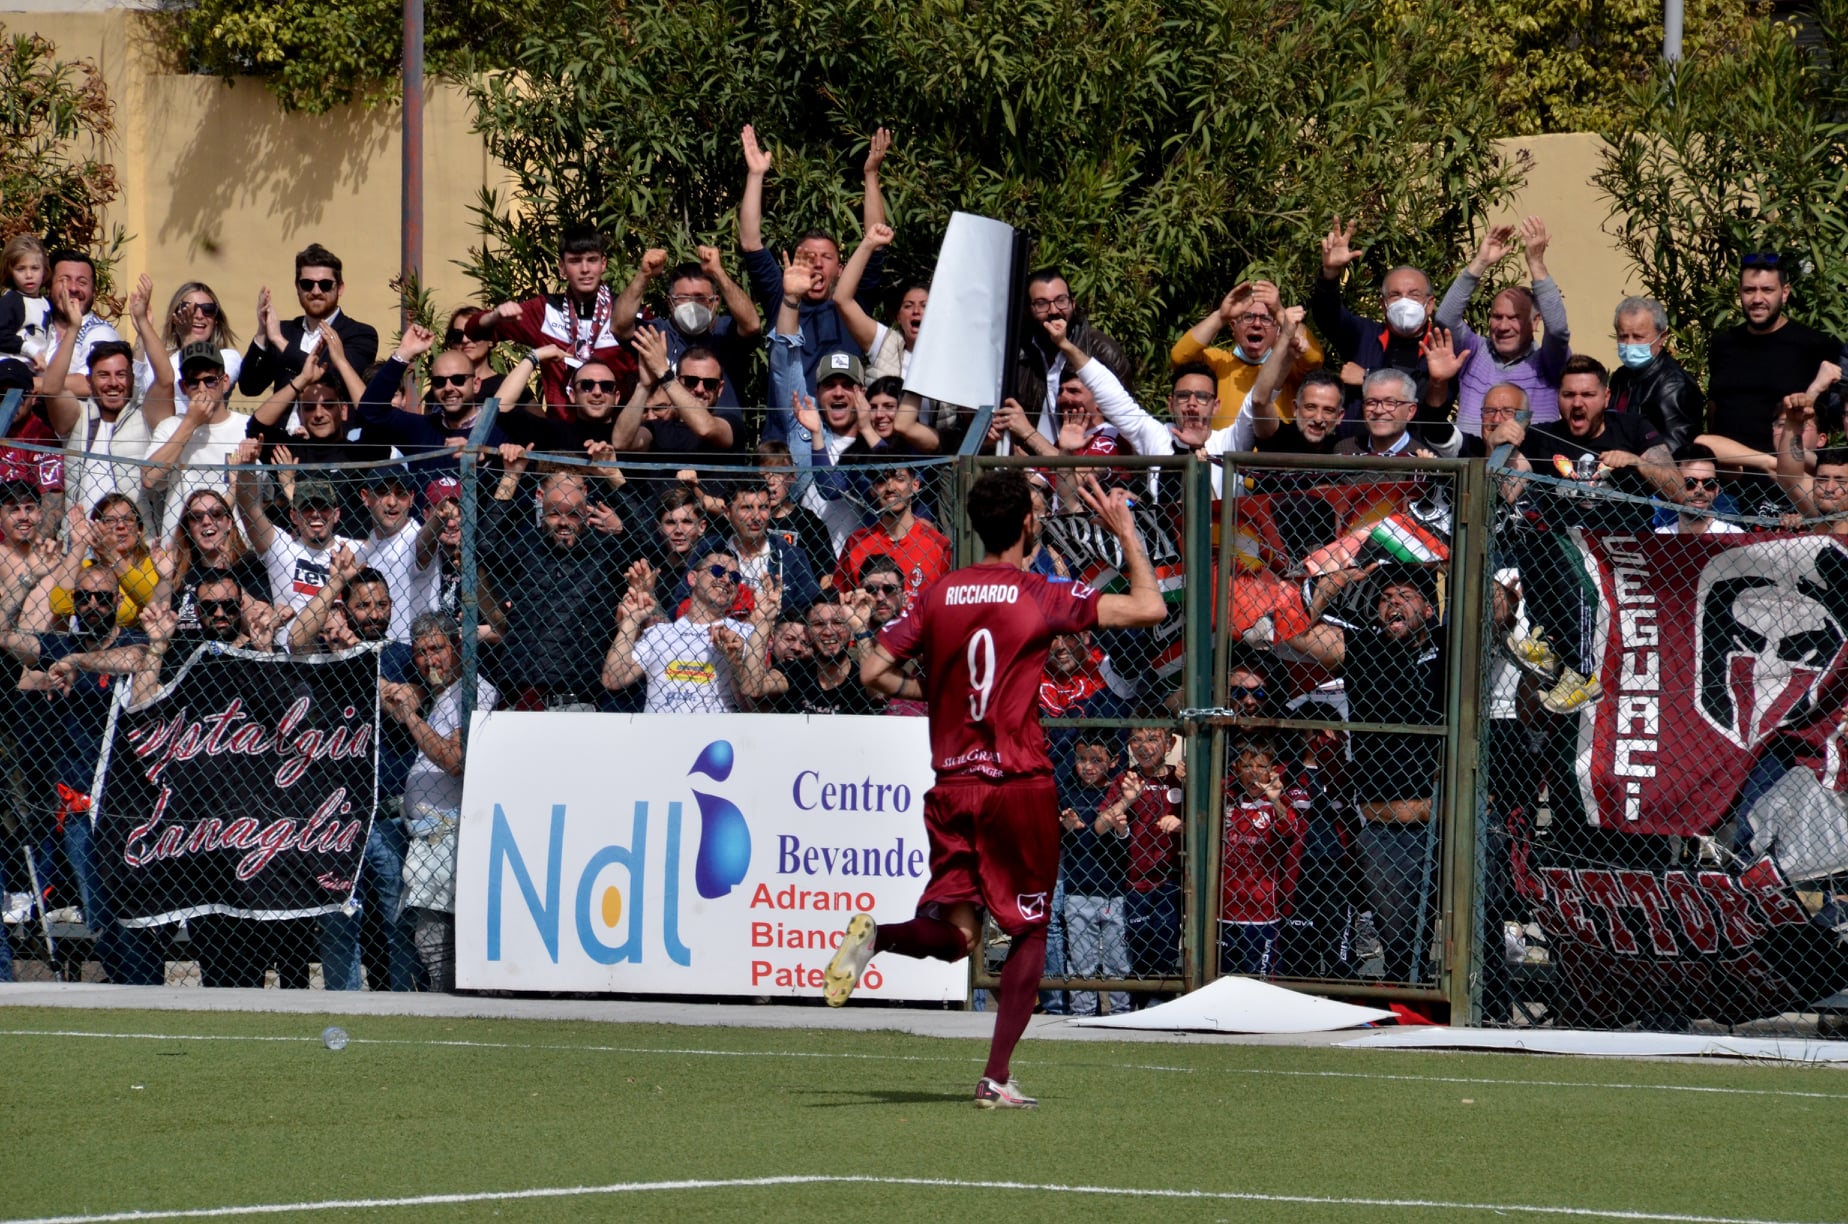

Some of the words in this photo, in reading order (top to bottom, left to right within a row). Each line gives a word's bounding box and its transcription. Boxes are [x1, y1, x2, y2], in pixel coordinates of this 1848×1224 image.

[1039, 509, 1180, 568] BROX
[945, 585, 1018, 605] RICCIARDO
[967, 628, 996, 721] 9
[793, 770, 911, 813] Centro
[776, 835, 924, 877] Bevande
[750, 883, 875, 911] Adrano
[751, 922, 846, 950] Bianc
[751, 960, 884, 990] Pateò
